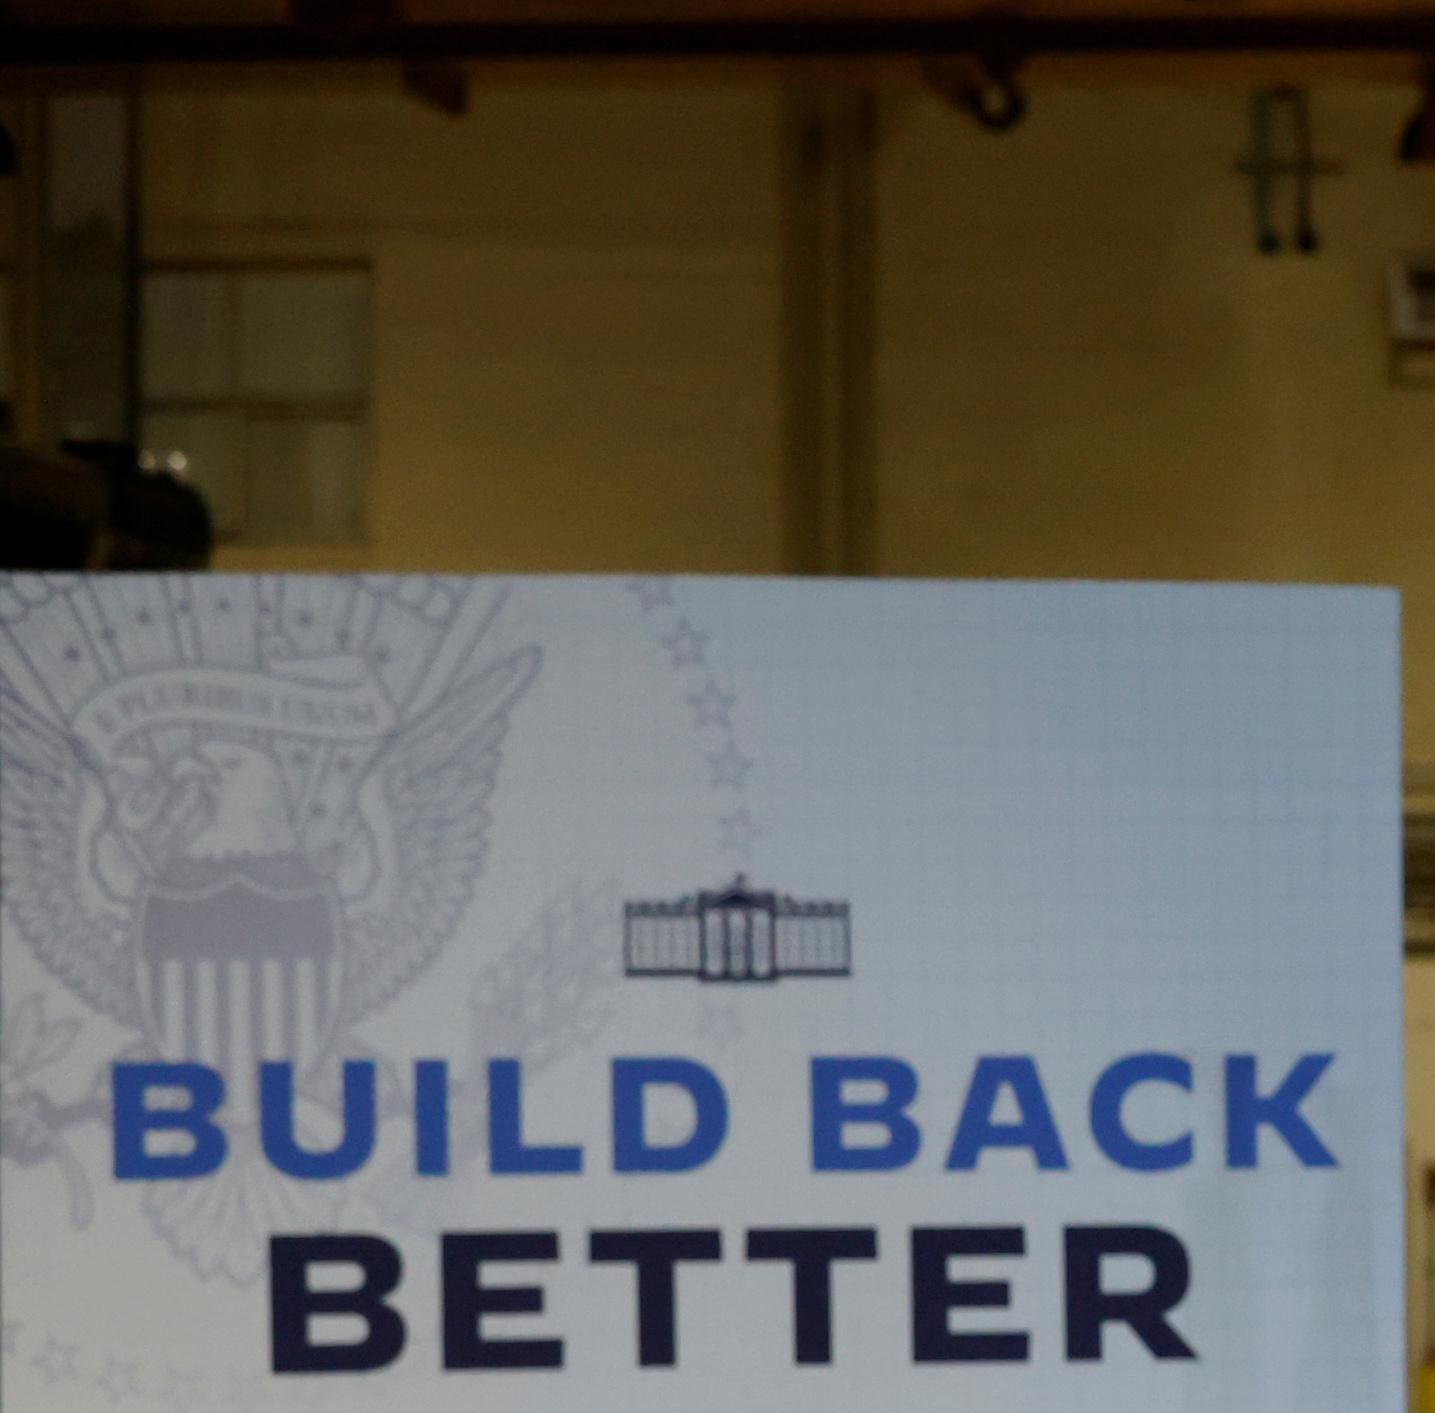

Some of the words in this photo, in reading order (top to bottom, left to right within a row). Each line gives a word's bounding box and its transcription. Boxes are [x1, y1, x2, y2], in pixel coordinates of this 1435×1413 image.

[111, 1055, 731, 1181] BUILD
[809, 1050, 1339, 1175] BACK
[268, 1224, 1200, 1376] BETTER
